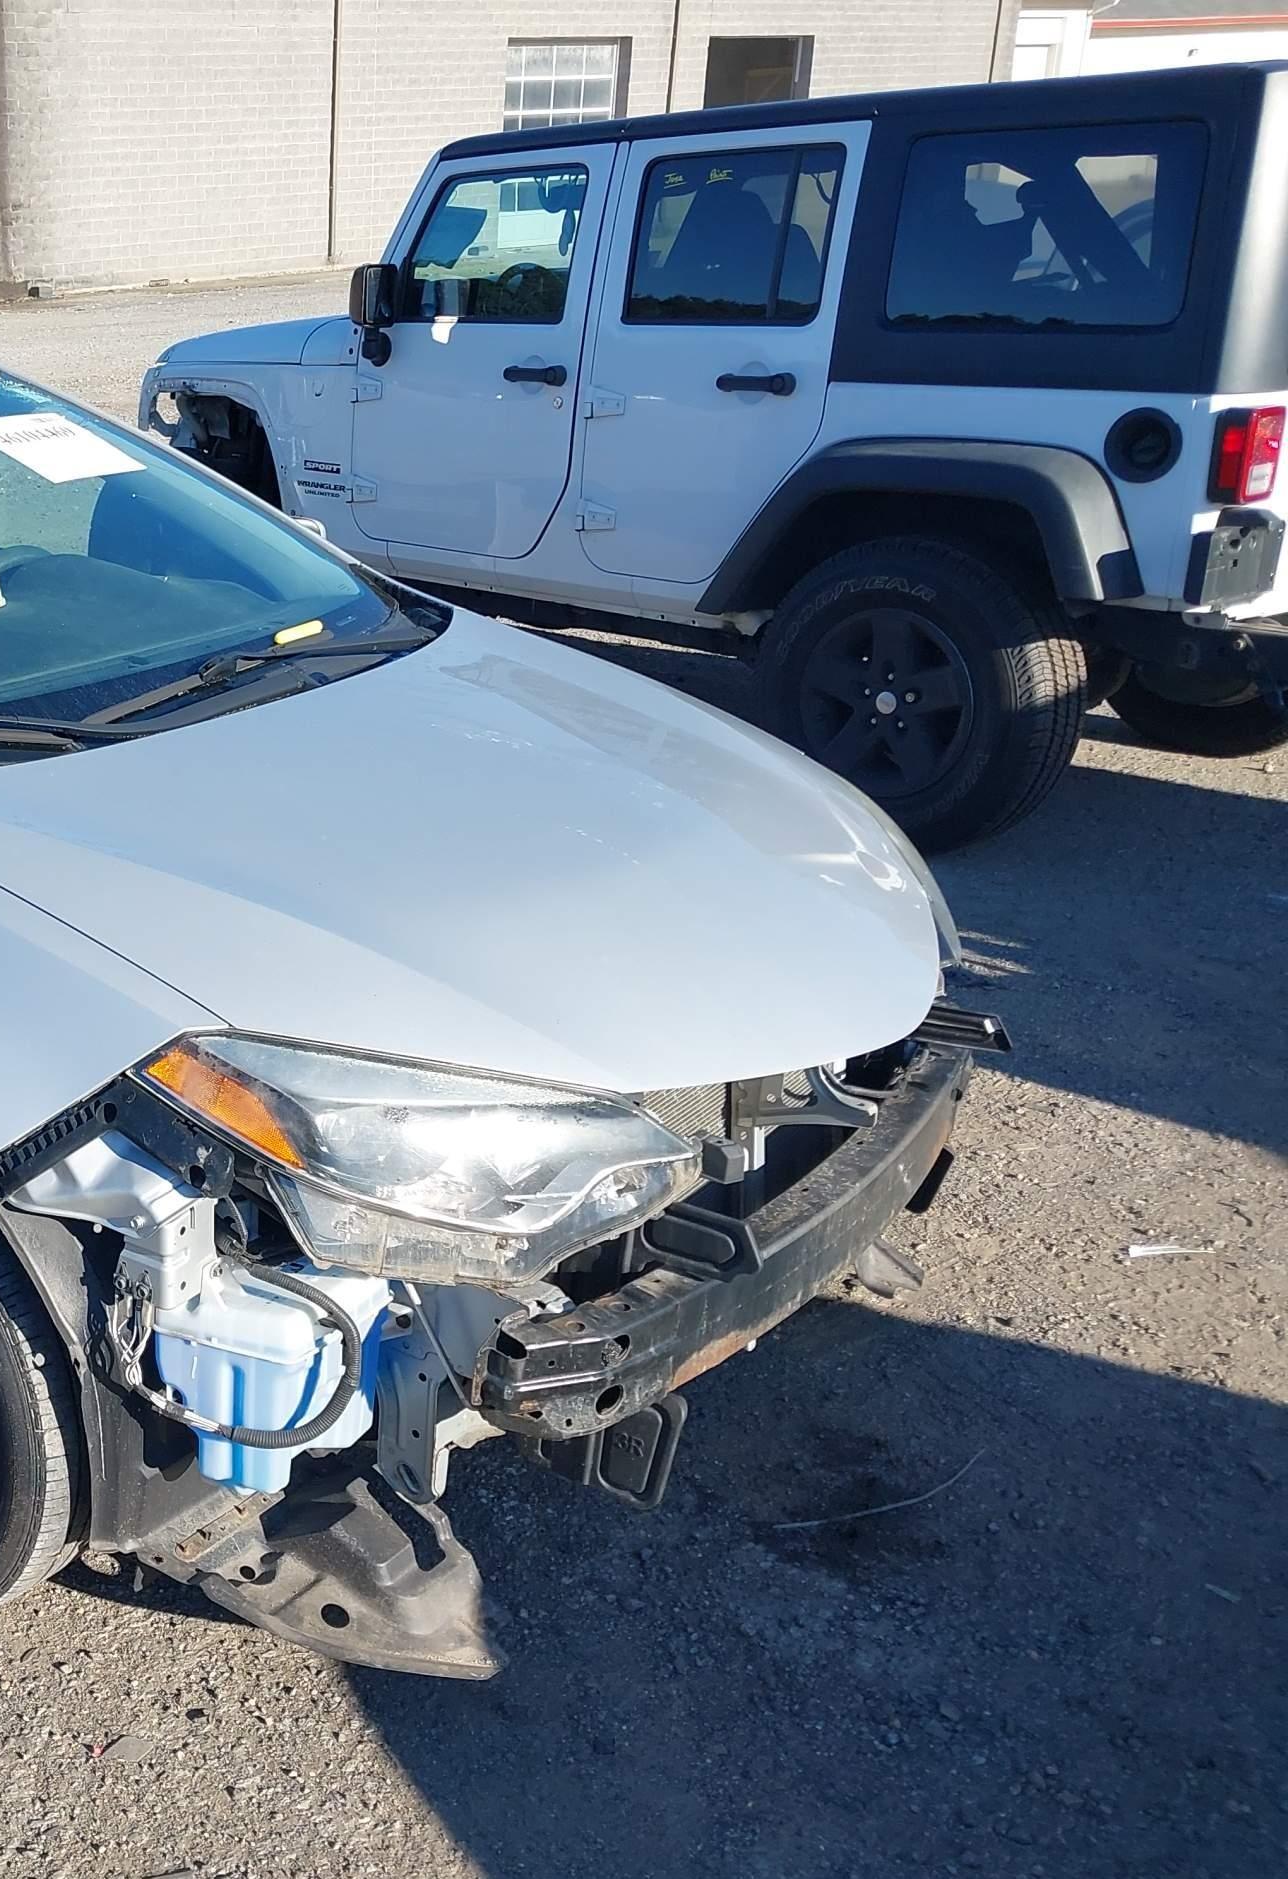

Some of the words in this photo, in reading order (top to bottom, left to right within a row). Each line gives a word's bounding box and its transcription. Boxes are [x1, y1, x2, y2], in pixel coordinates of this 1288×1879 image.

[305, 461, 339, 472] SPORT
[297, 480, 346, 493] WRANGLER
[304, 489, 341, 498] UNLIMITED
